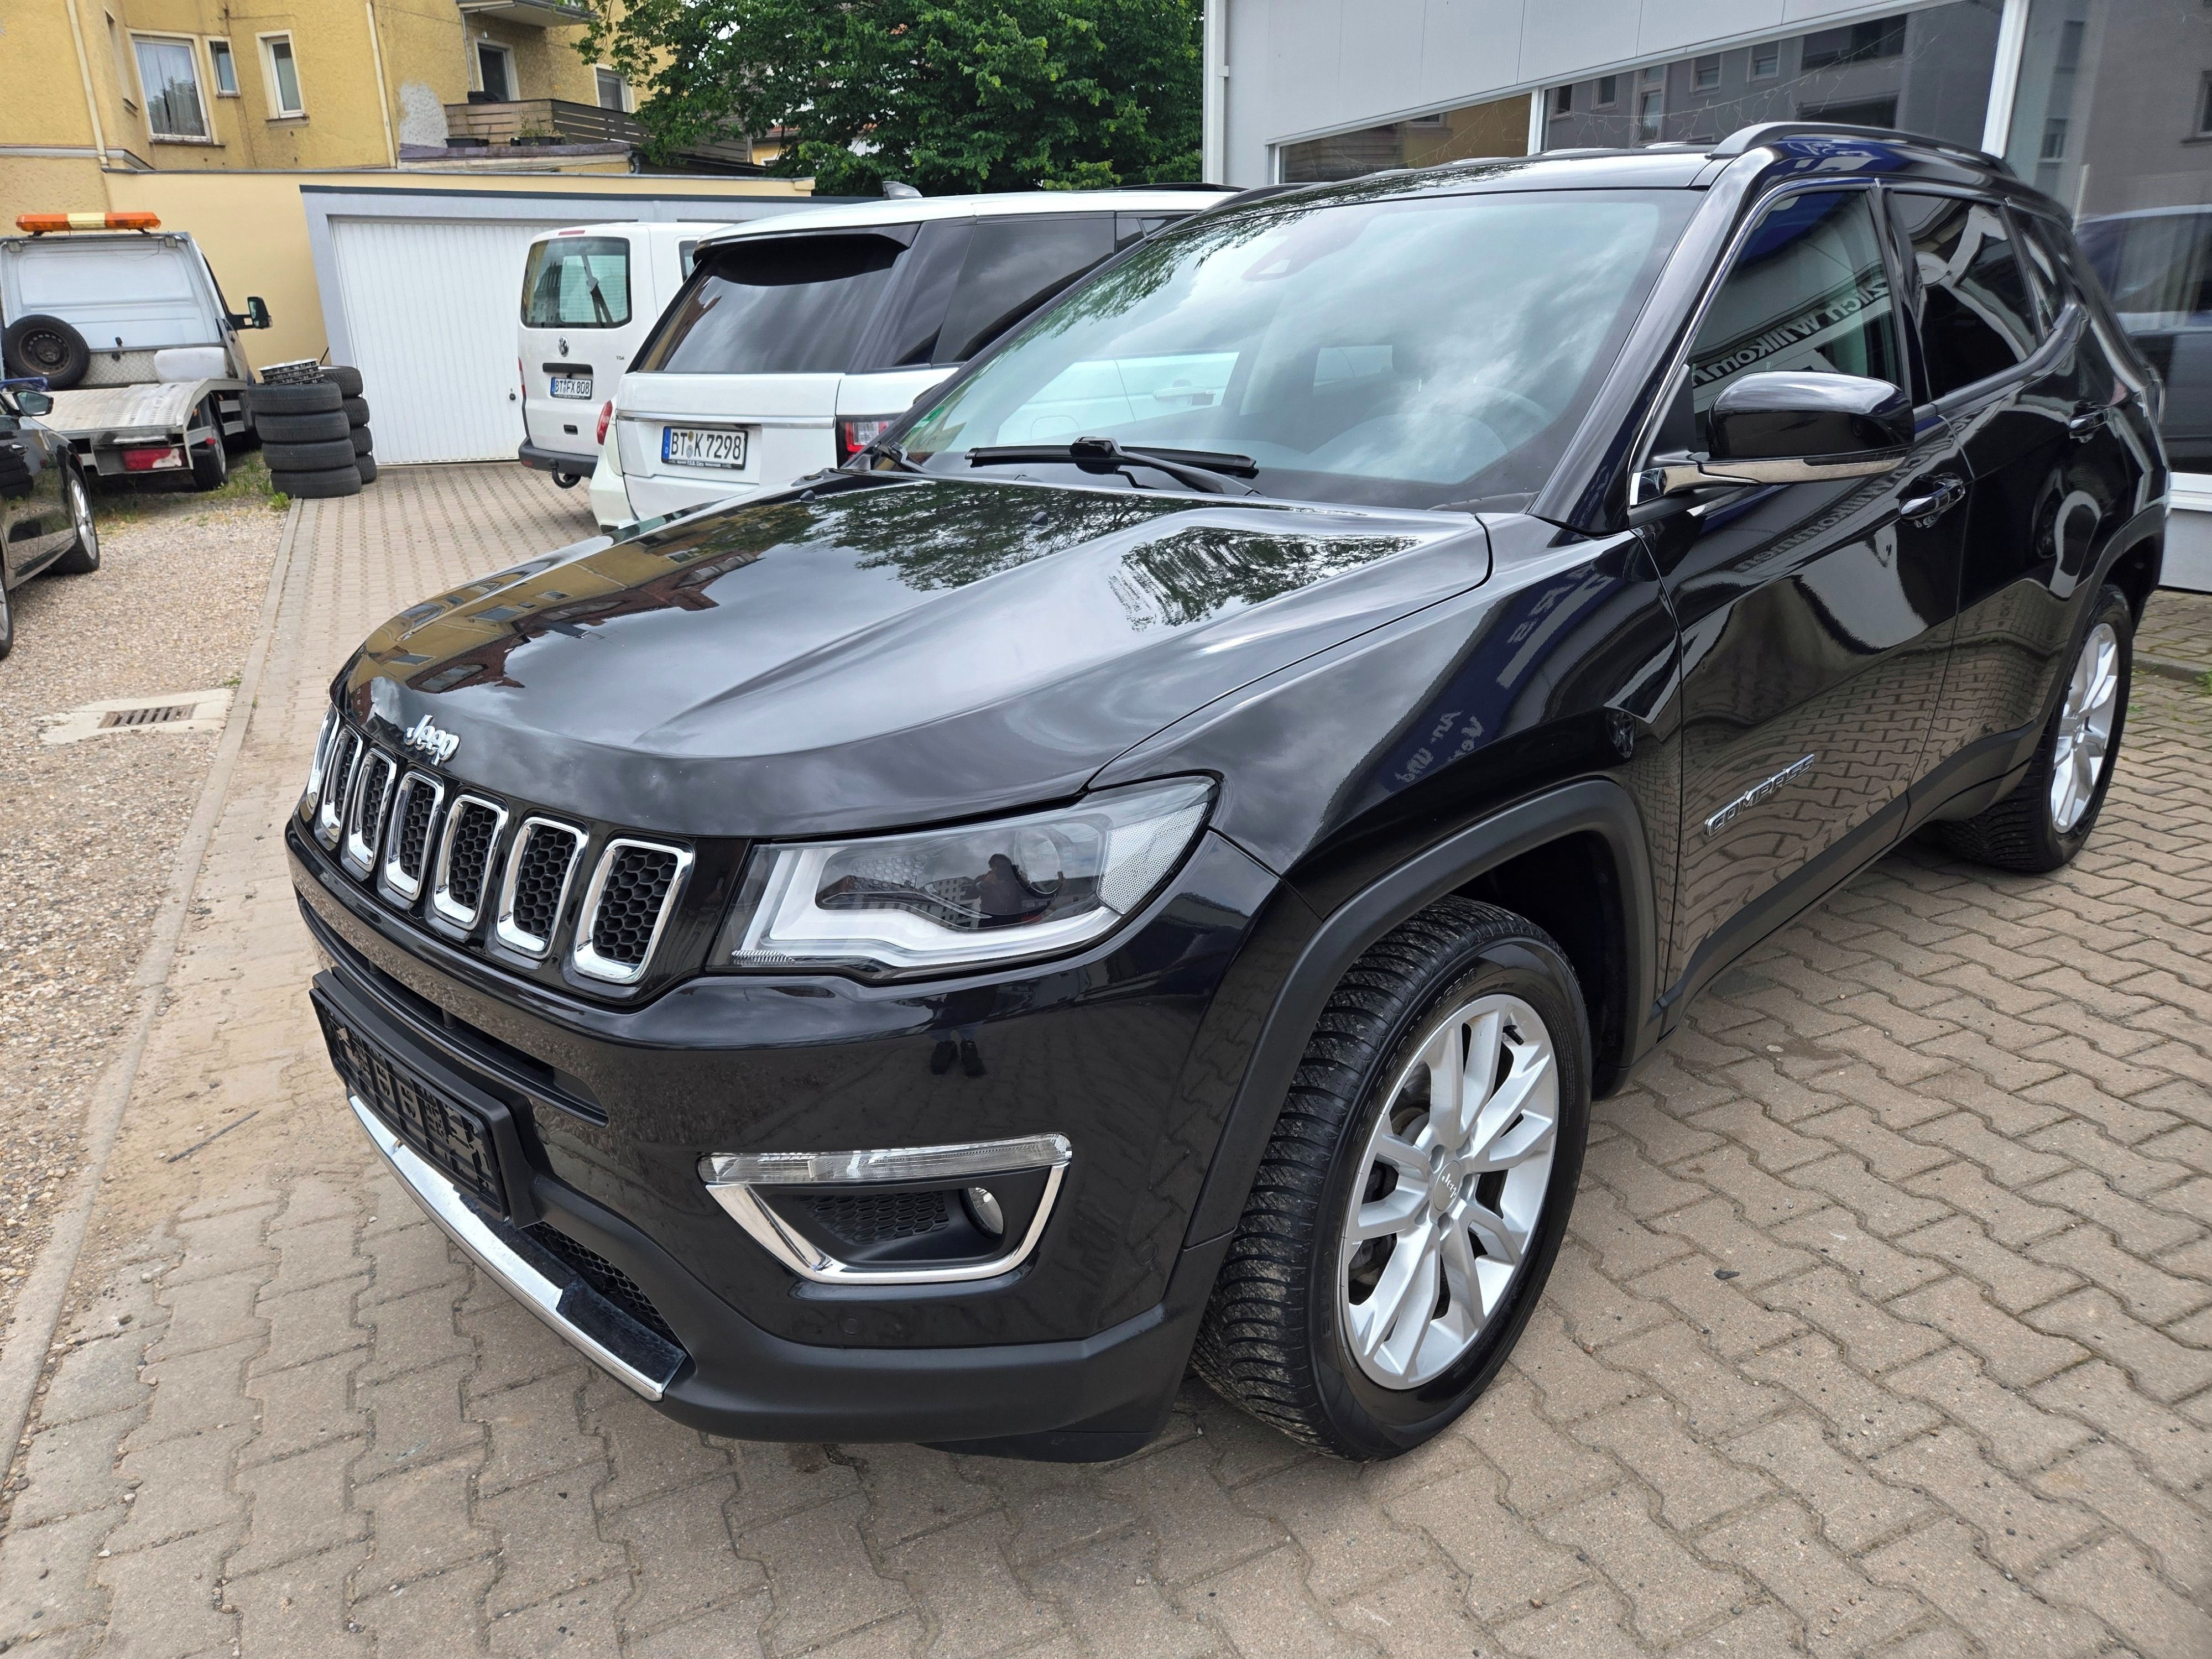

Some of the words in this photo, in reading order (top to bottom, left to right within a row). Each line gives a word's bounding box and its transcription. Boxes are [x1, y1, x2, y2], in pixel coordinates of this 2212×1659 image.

[566, 381, 575, 393] FX
[576, 382, 590, 394] 808
[671, 432, 687, 456] BT
[694, 433, 703, 457] K
[706, 434, 742, 460] 7298
[403, 714, 460, 766] Jeep
